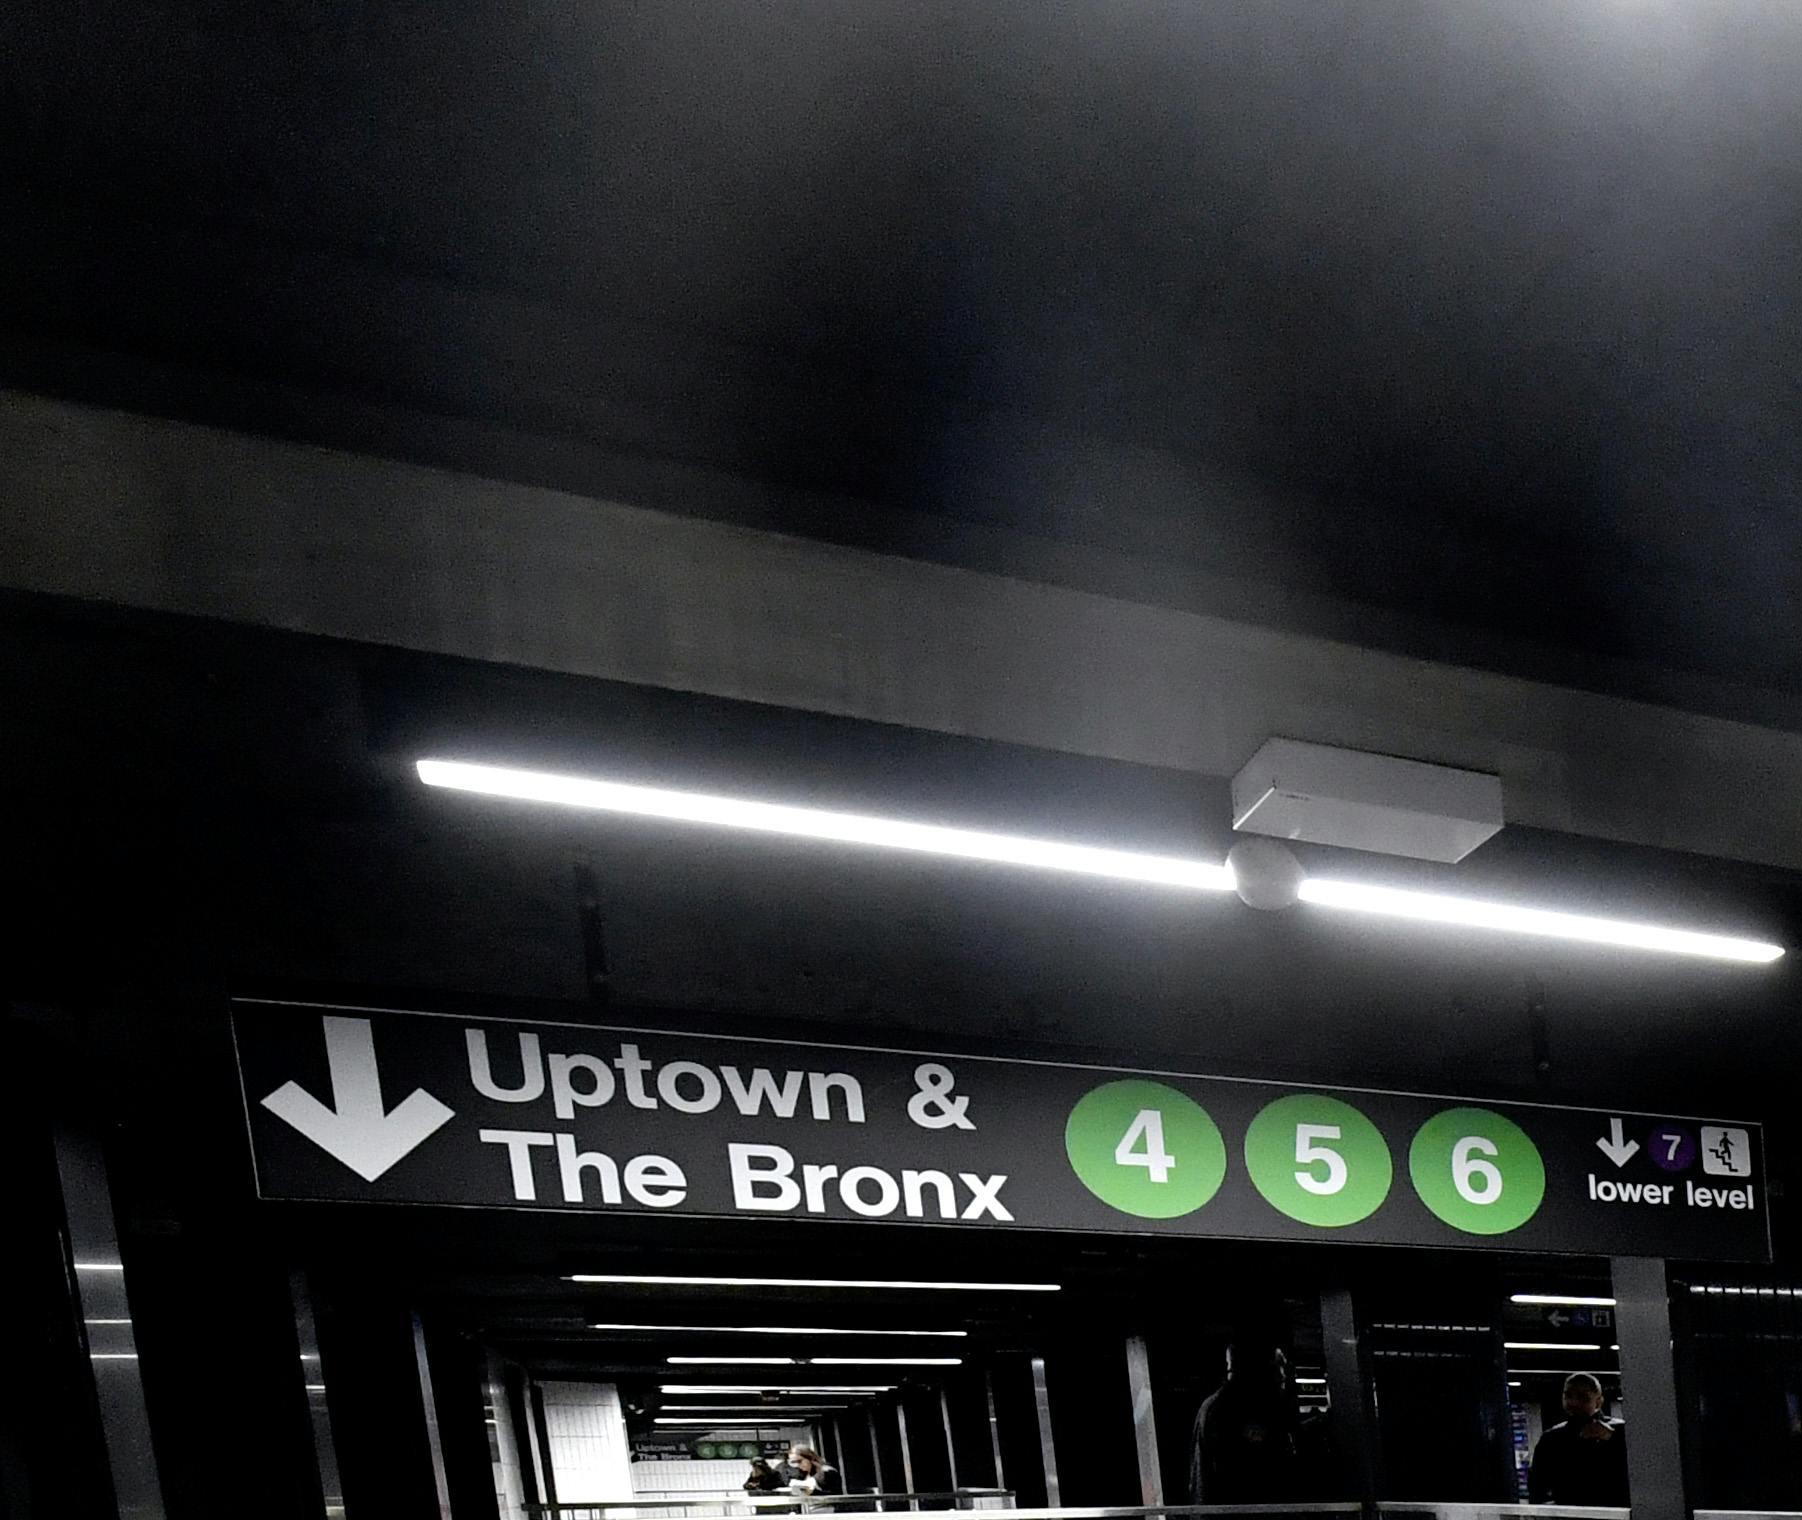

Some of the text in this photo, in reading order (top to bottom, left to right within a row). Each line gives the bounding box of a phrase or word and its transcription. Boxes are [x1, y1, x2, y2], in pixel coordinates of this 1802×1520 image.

[464, 1028, 977, 1132] Uptown &
[479, 1128, 1015, 1222] The Bronx
[1115, 1108, 1503, 1206] 4 5 6
[1588, 1173, 1754, 1210] lower level
[1662, 1134, 1681, 1161] 7
